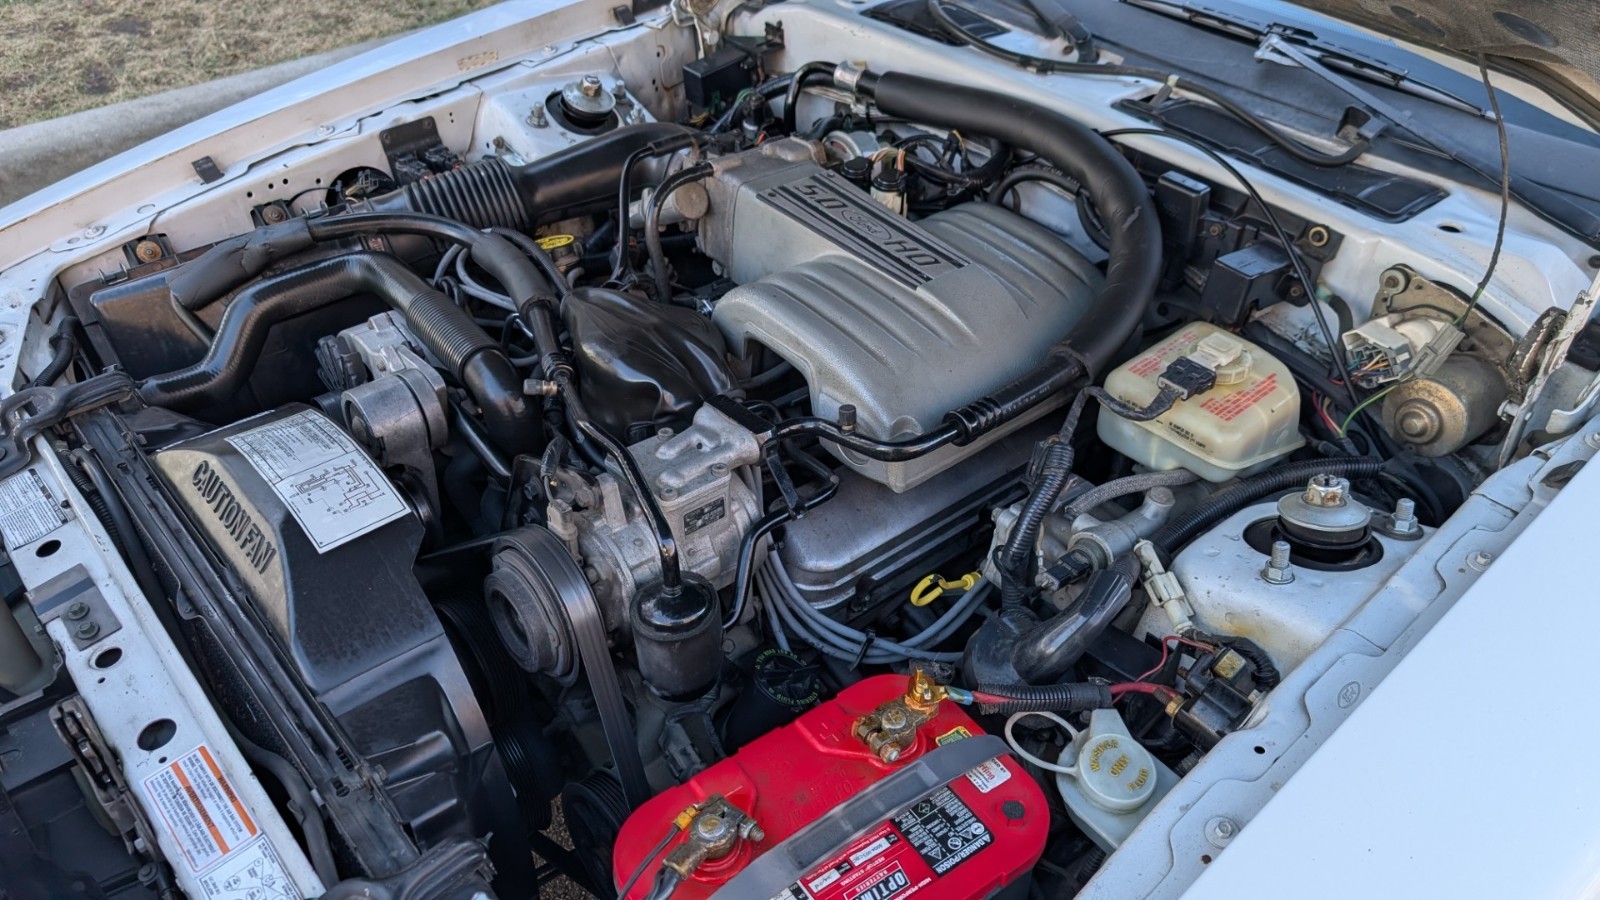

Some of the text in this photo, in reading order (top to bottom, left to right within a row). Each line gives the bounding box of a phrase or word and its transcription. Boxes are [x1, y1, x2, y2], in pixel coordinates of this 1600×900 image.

[795, 184, 942, 266] 5.0 Ford HO
[191, 460, 277, 575] CAUTION FAN
[776, 693, 793, 704] FLUID
[1089, 739, 1119, 772] WASHER
[1109, 753, 1131, 778] ONLY
[216, 775, 237, 802] WARNING
[1127, 767, 1150, 792] FLUID
[183, 784, 216, 829] AVERTISSEMENT
[933, 838, 985, 874] DANGER/POISON
[839, 868, 864, 886] STARTING
[854, 869, 888, 892] BATTERIES
[855, 869, 906, 900] OPTIM
